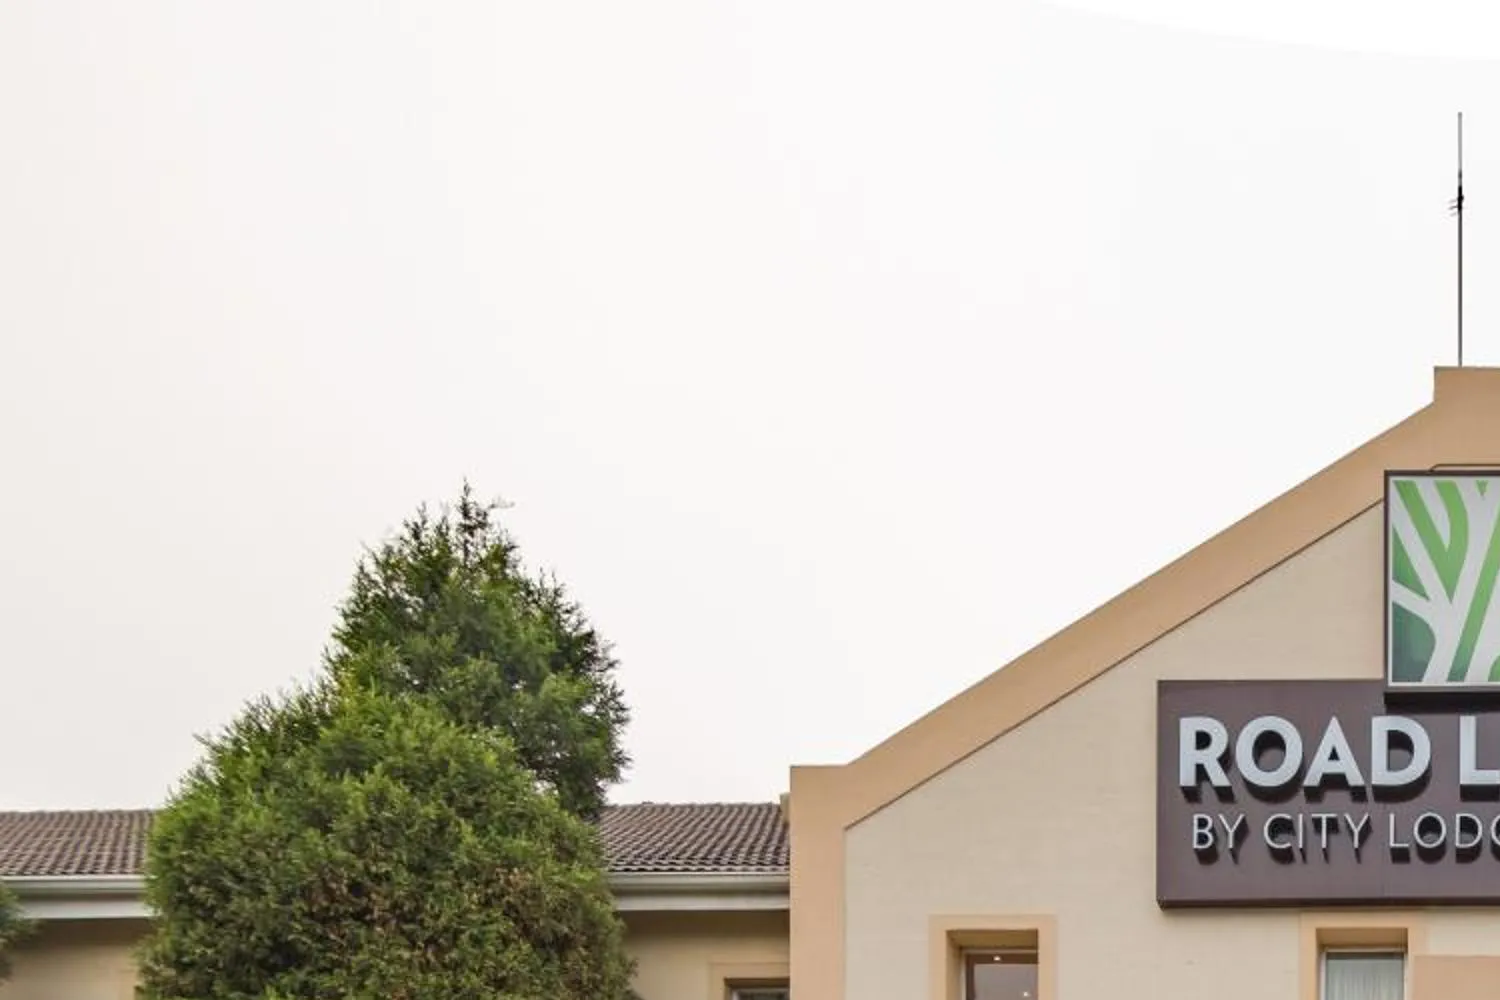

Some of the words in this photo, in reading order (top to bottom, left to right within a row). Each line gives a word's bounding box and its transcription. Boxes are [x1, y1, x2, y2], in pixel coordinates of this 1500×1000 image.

[1178, 715, 1432, 787] ROAD
[1192, 813, 1245, 850] BY
[1263, 812, 1370, 849] CITY
